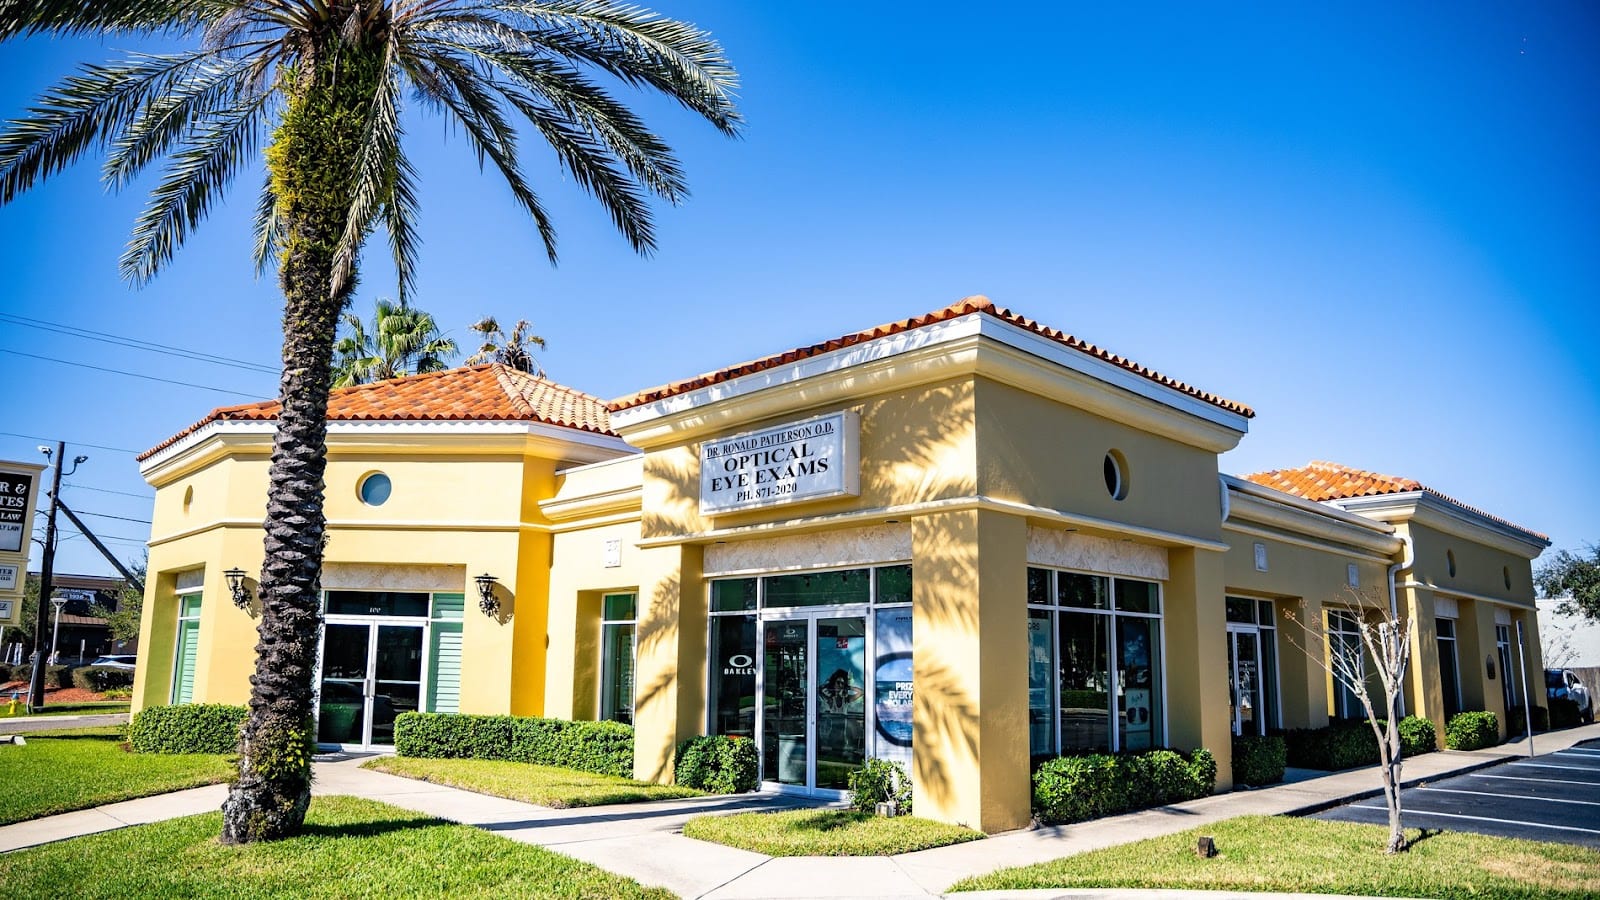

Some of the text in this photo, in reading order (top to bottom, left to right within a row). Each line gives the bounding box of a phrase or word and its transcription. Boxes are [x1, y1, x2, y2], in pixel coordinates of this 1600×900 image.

[706, 422, 834, 457] DR. RONALD PATTERSON O.D.
[724, 443, 814, 472] OPTICAL
[711, 457, 829, 492] EYE EXAMS
[736, 482, 797, 502] PH. 871-2020
[1, 512, 21, 521] LAW
[888, 690, 913, 700] EVERY
